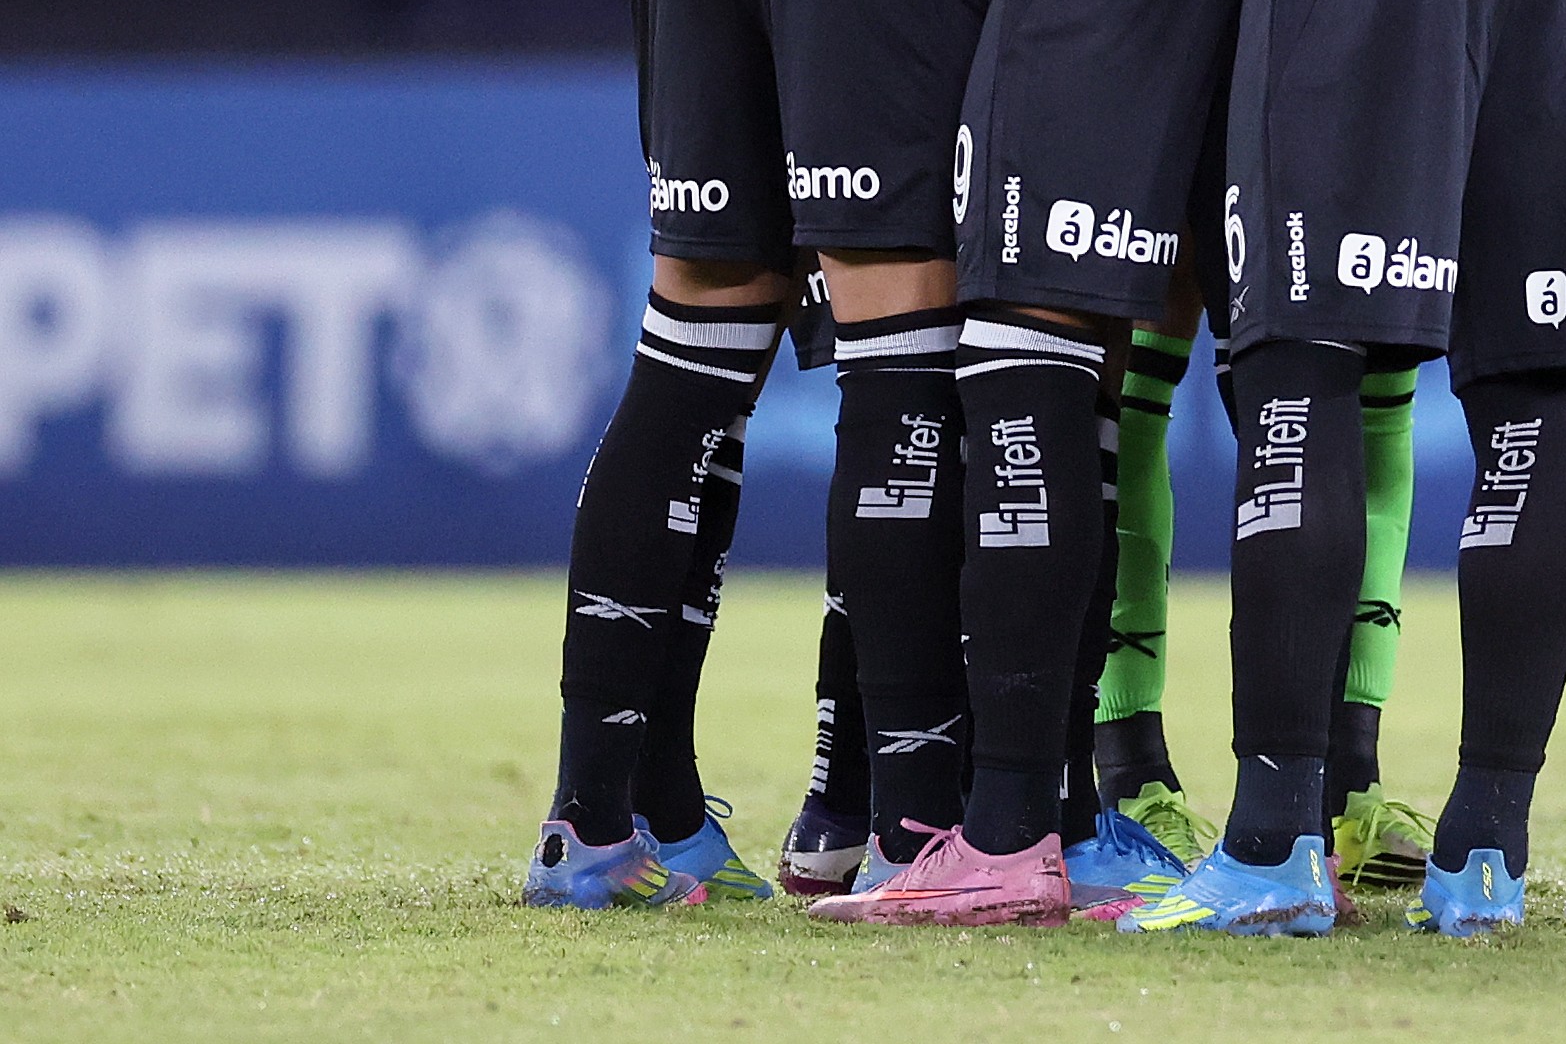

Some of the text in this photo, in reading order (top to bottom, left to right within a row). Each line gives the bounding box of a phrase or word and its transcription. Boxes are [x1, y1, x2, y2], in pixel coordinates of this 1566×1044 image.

[1002, 176, 1021, 263] Reebok
[1094, 208, 1179, 265] álam
[1224, 185, 1245, 284] 6
[1286, 212, 1310, 301] Reebok
[1386, 237, 1458, 294] álam
[892, 414, 946, 488] Lifef
[991, 415, 1048, 511] Lifefit
[1254, 397, 1311, 495] Lifefit
[1476, 417, 1543, 513] Lifefit
